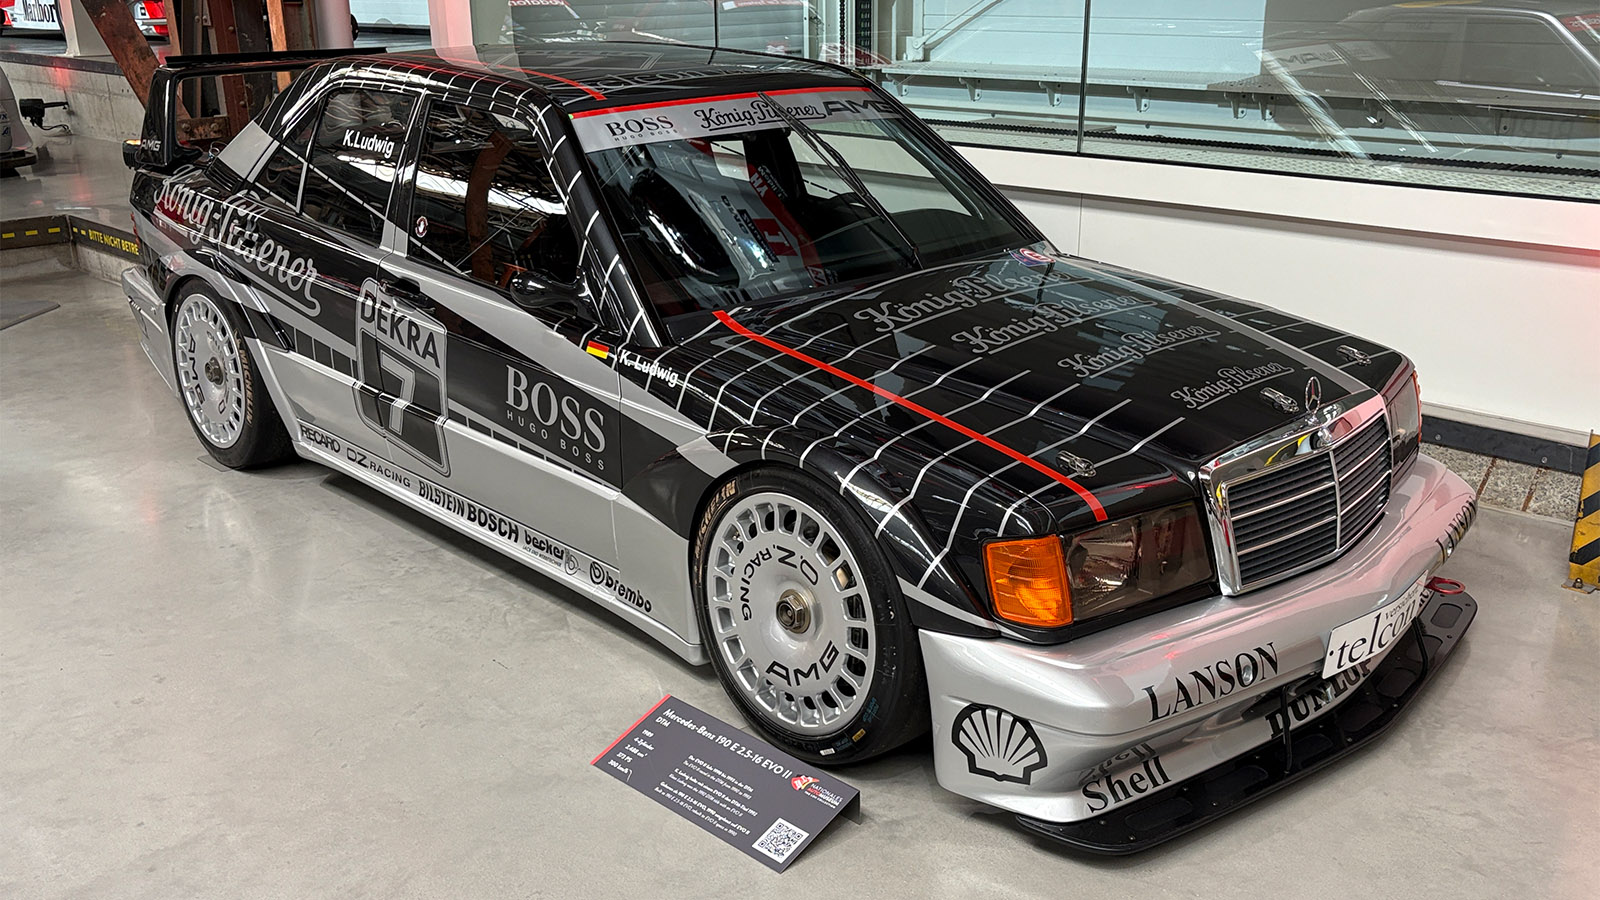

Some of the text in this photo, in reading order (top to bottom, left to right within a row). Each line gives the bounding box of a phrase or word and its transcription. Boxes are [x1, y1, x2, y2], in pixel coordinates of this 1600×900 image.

[605, 115, 675, 137] BOSS
[694, 100, 827, 131] König-Piener
[823, 99, 894, 116] AMG
[140, 139, 162, 152] AMG
[614, 129, 678, 142] HUGO BOSS
[88, 229, 104, 243] BITTE
[104, 234, 121, 249] NICHT
[360, 295, 441, 369] DEKRA
[951, 295, 1158, 354] König-Pilsener
[638, 356, 679, 388] Ludwig
[1057, 325, 1221, 379] König-Pilsener
[379, 349, 417, 437] 7
[1170, 362, 1295, 410] König-Pilsener
[505, 364, 606, 453] BOSS
[300, 424, 341, 453] RECARO
[507, 409, 605, 471] HUGO BOSS
[369, 461, 411, 488] RACING
[418, 480, 465, 518] BILSTEIN
[467, 504, 520, 544] BOSCH
[524, 529, 565, 561] becker
[605, 570, 653, 613] brembo
[740, 547, 773, 621] RACING
[765, 640, 840, 687] AMG
[1141, 641, 1279, 723] LANSON
[655, 716, 671, 728] DTM
[662, 708, 716, 741] Mercedes-Benz
[716, 734, 732, 748] 190
[732, 741, 741, 752] E
[740, 745, 764, 765] 2.5-16
[761, 758, 783, 774] EVO
[1081, 755, 1172, 814] Shell
